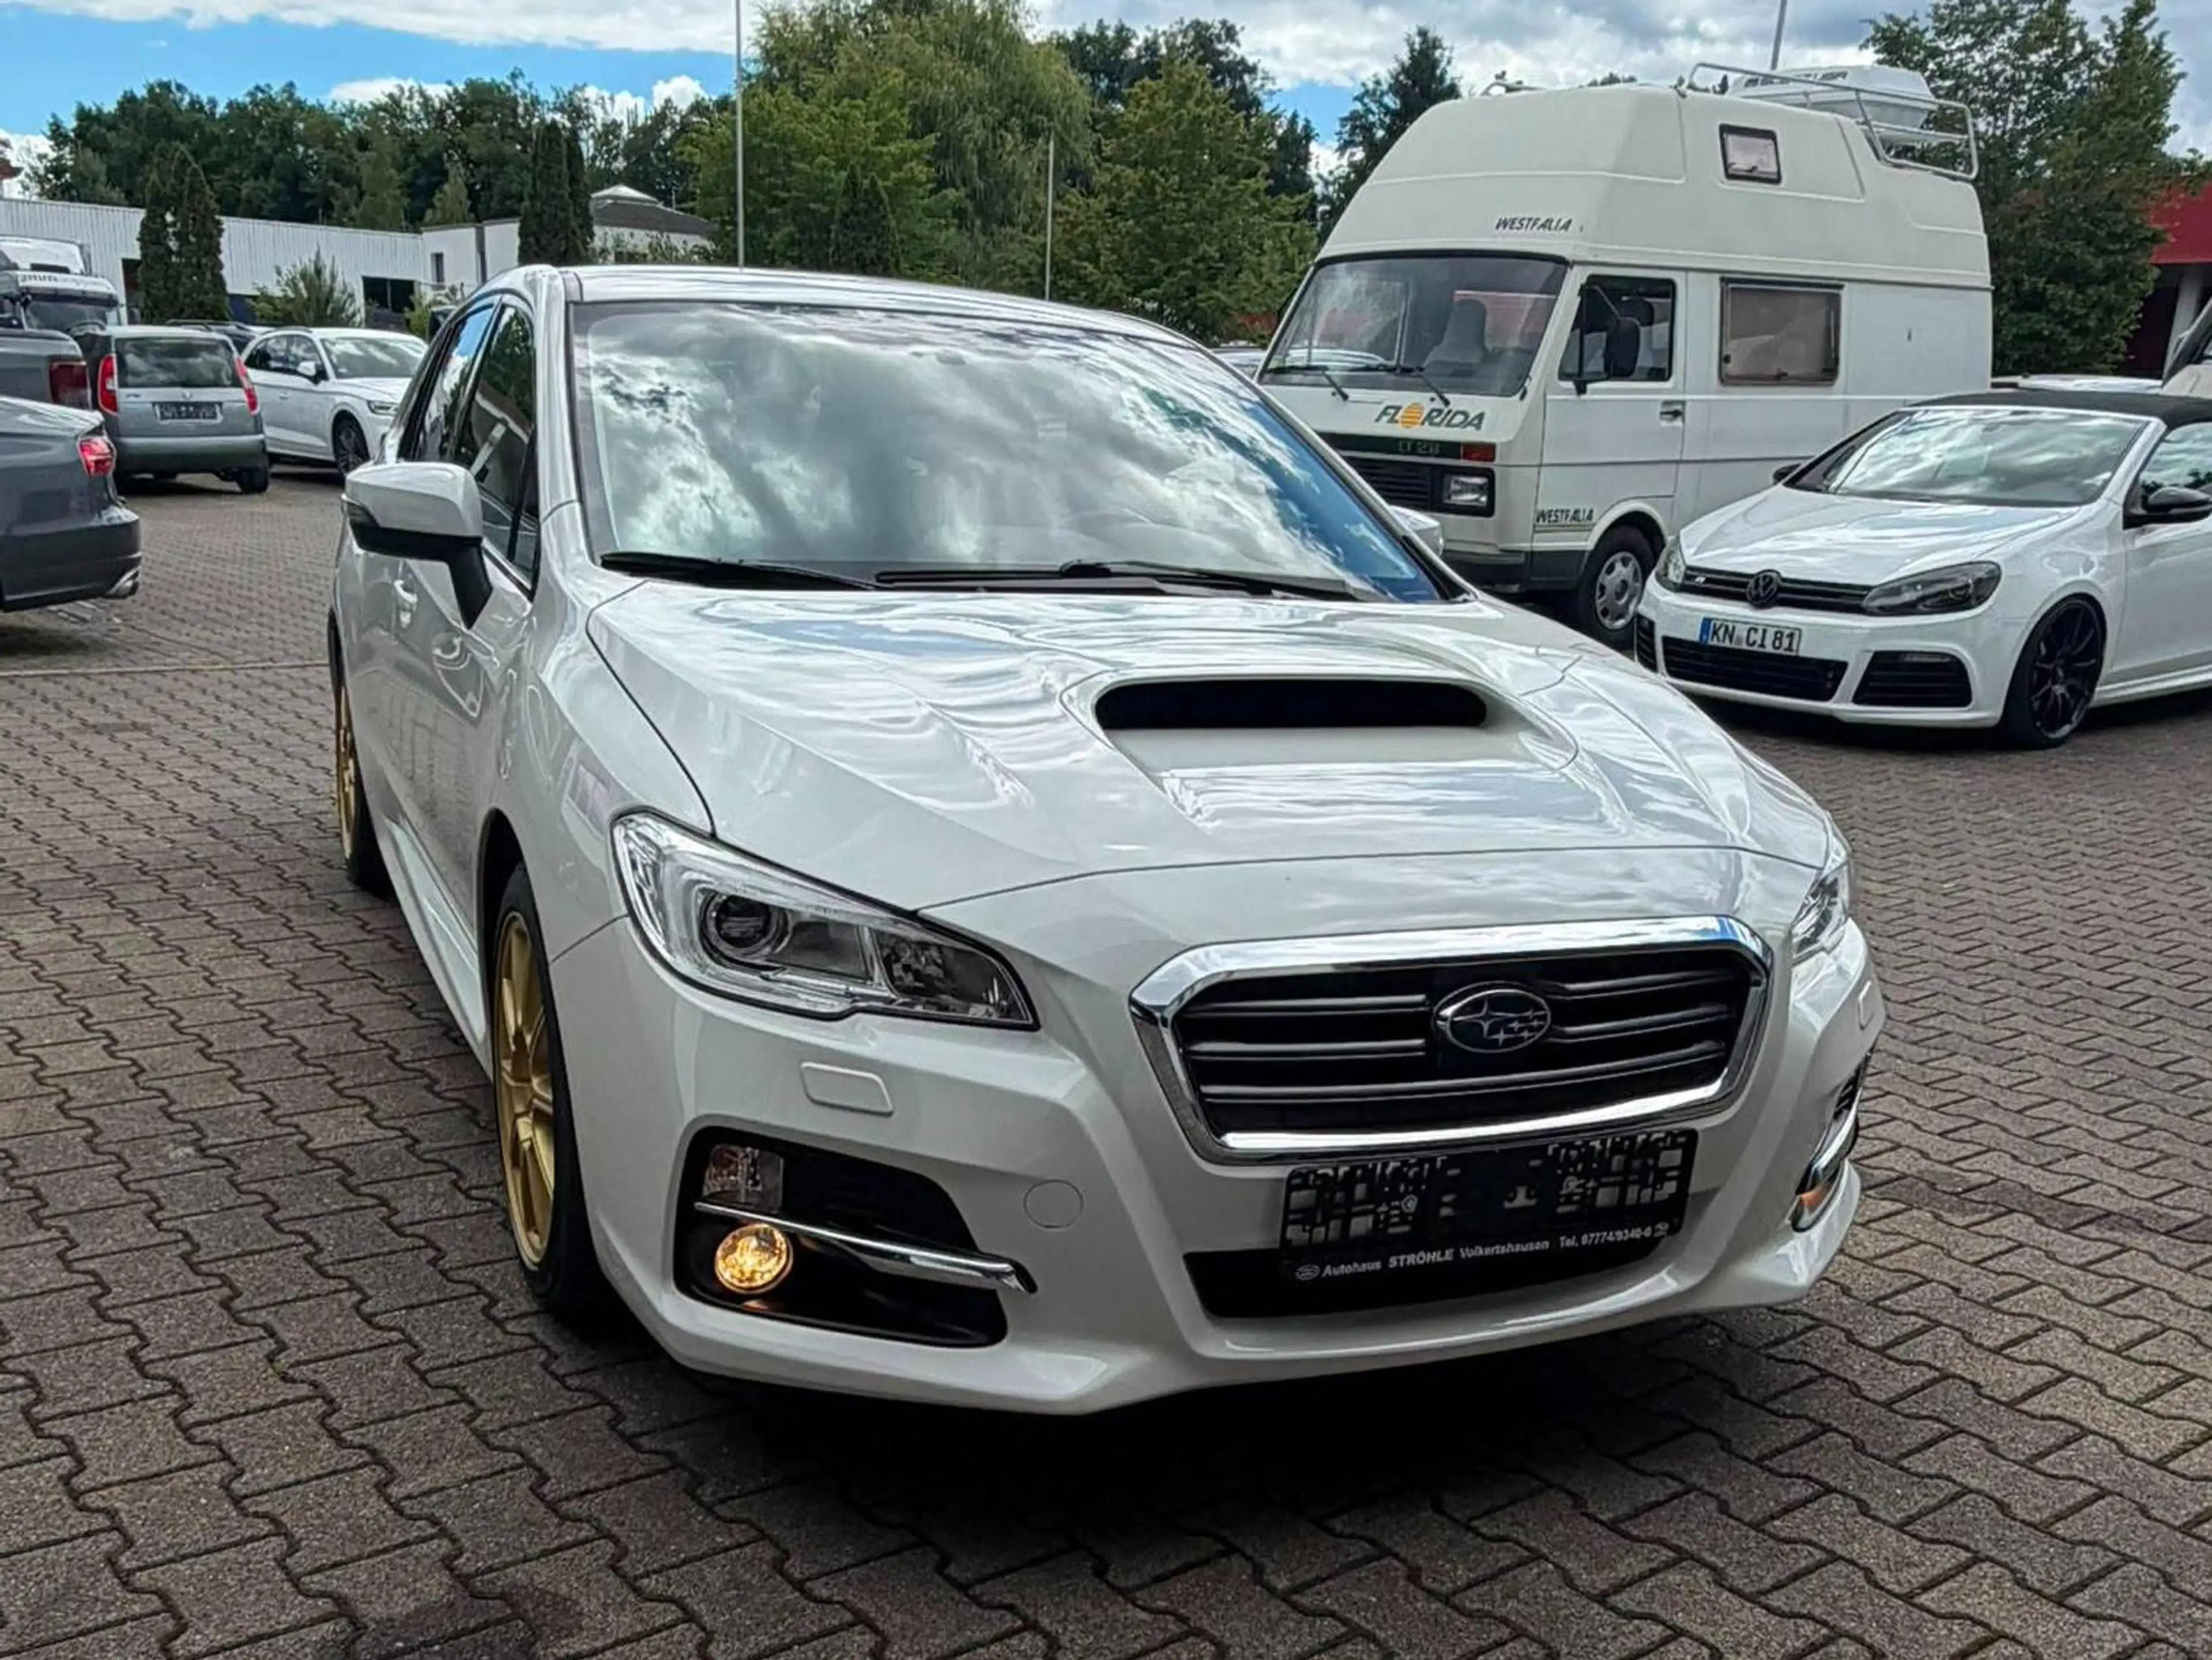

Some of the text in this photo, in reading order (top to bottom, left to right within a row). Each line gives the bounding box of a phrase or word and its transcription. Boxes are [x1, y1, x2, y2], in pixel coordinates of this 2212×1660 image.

[1494, 217, 1573, 232] WESTFALIA
[1374, 402, 1486, 431] FLORIDA
[1710, 622, 1735, 645] KN
[1772, 630, 1796, 652] 81
[1322, 1261, 1382, 1277] Autohaus
[1559, 1235, 1579, 1248] Tel.
